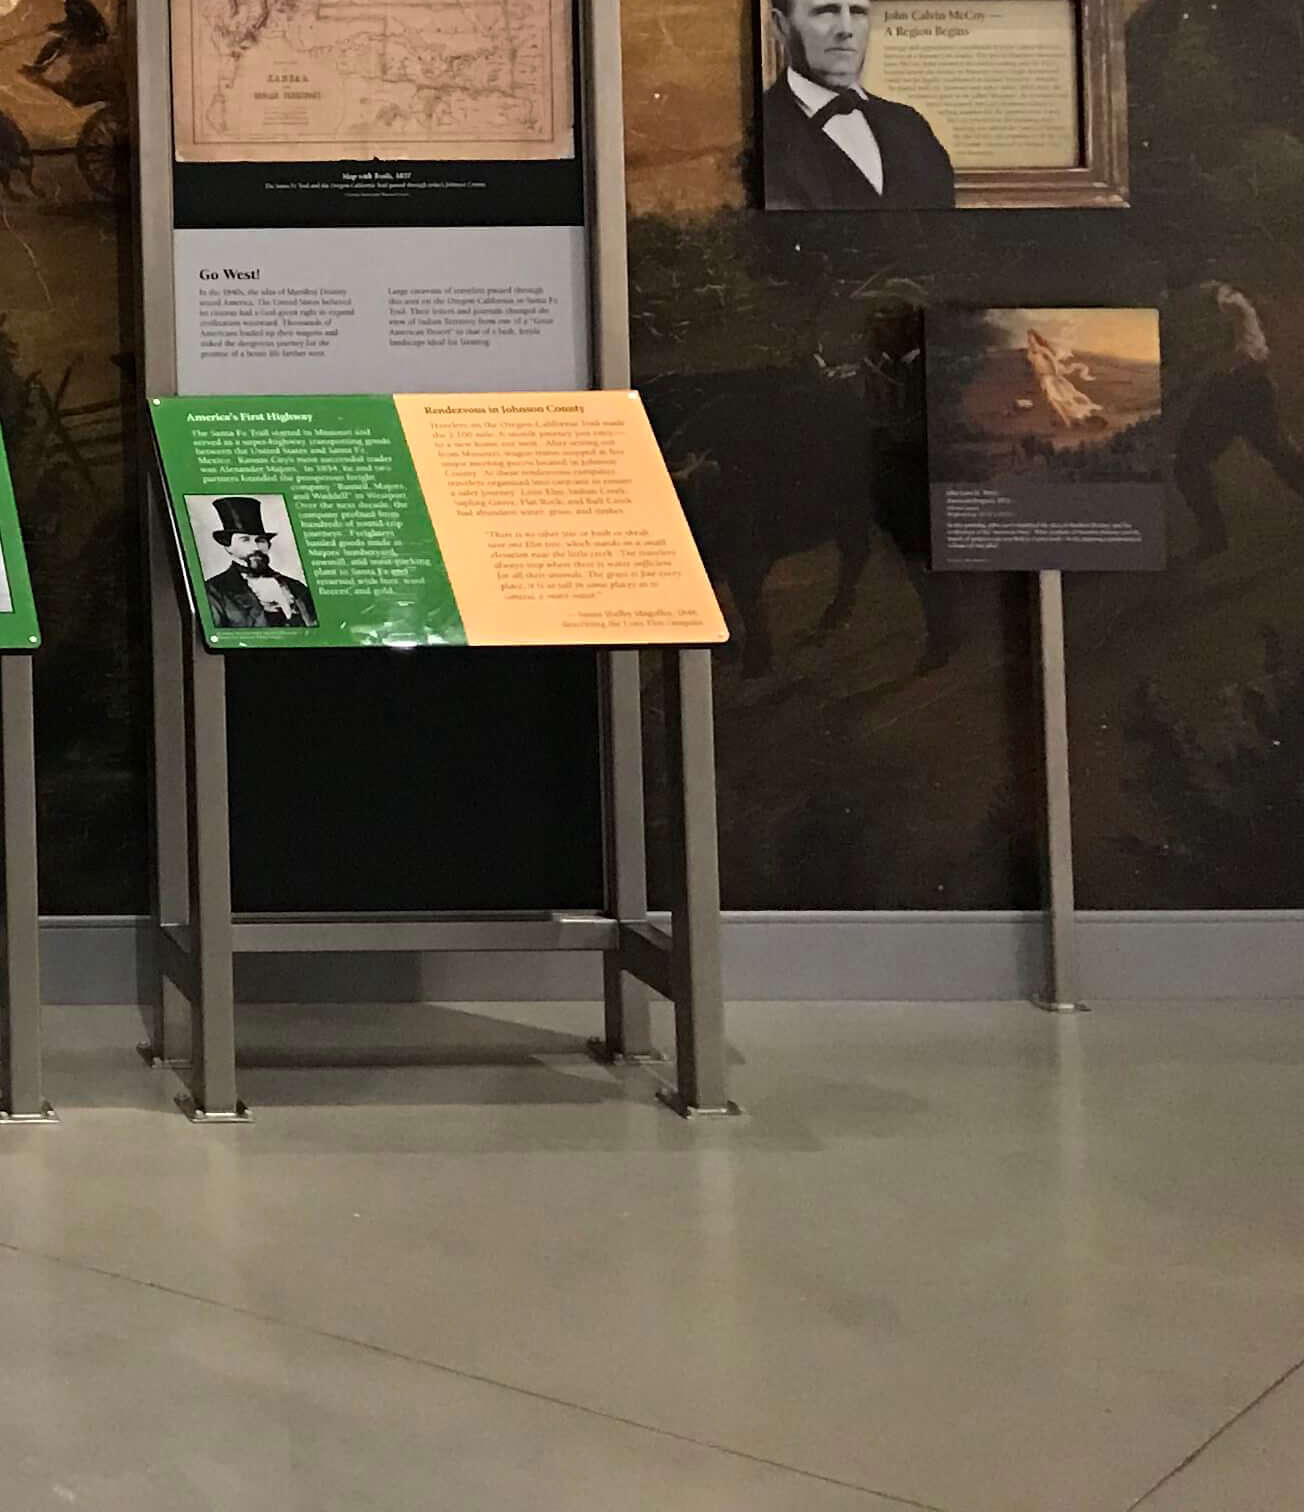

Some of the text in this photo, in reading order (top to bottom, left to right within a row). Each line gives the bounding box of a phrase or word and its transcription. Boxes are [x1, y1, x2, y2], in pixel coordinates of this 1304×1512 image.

[884, 11, 908, 23] John
[911, 10, 946, 21] Calvin
[948, 10, 986, 21] McCoy
[885, 26, 969, 38] A Region Begins
[200, 269, 260, 280] Go West!
[424, 406, 486, 414] Rendezvous
[500, 405, 544, 414] Johnson
[546, 405, 584, 413] County
[187, 412, 312, 423] America's First Highway
